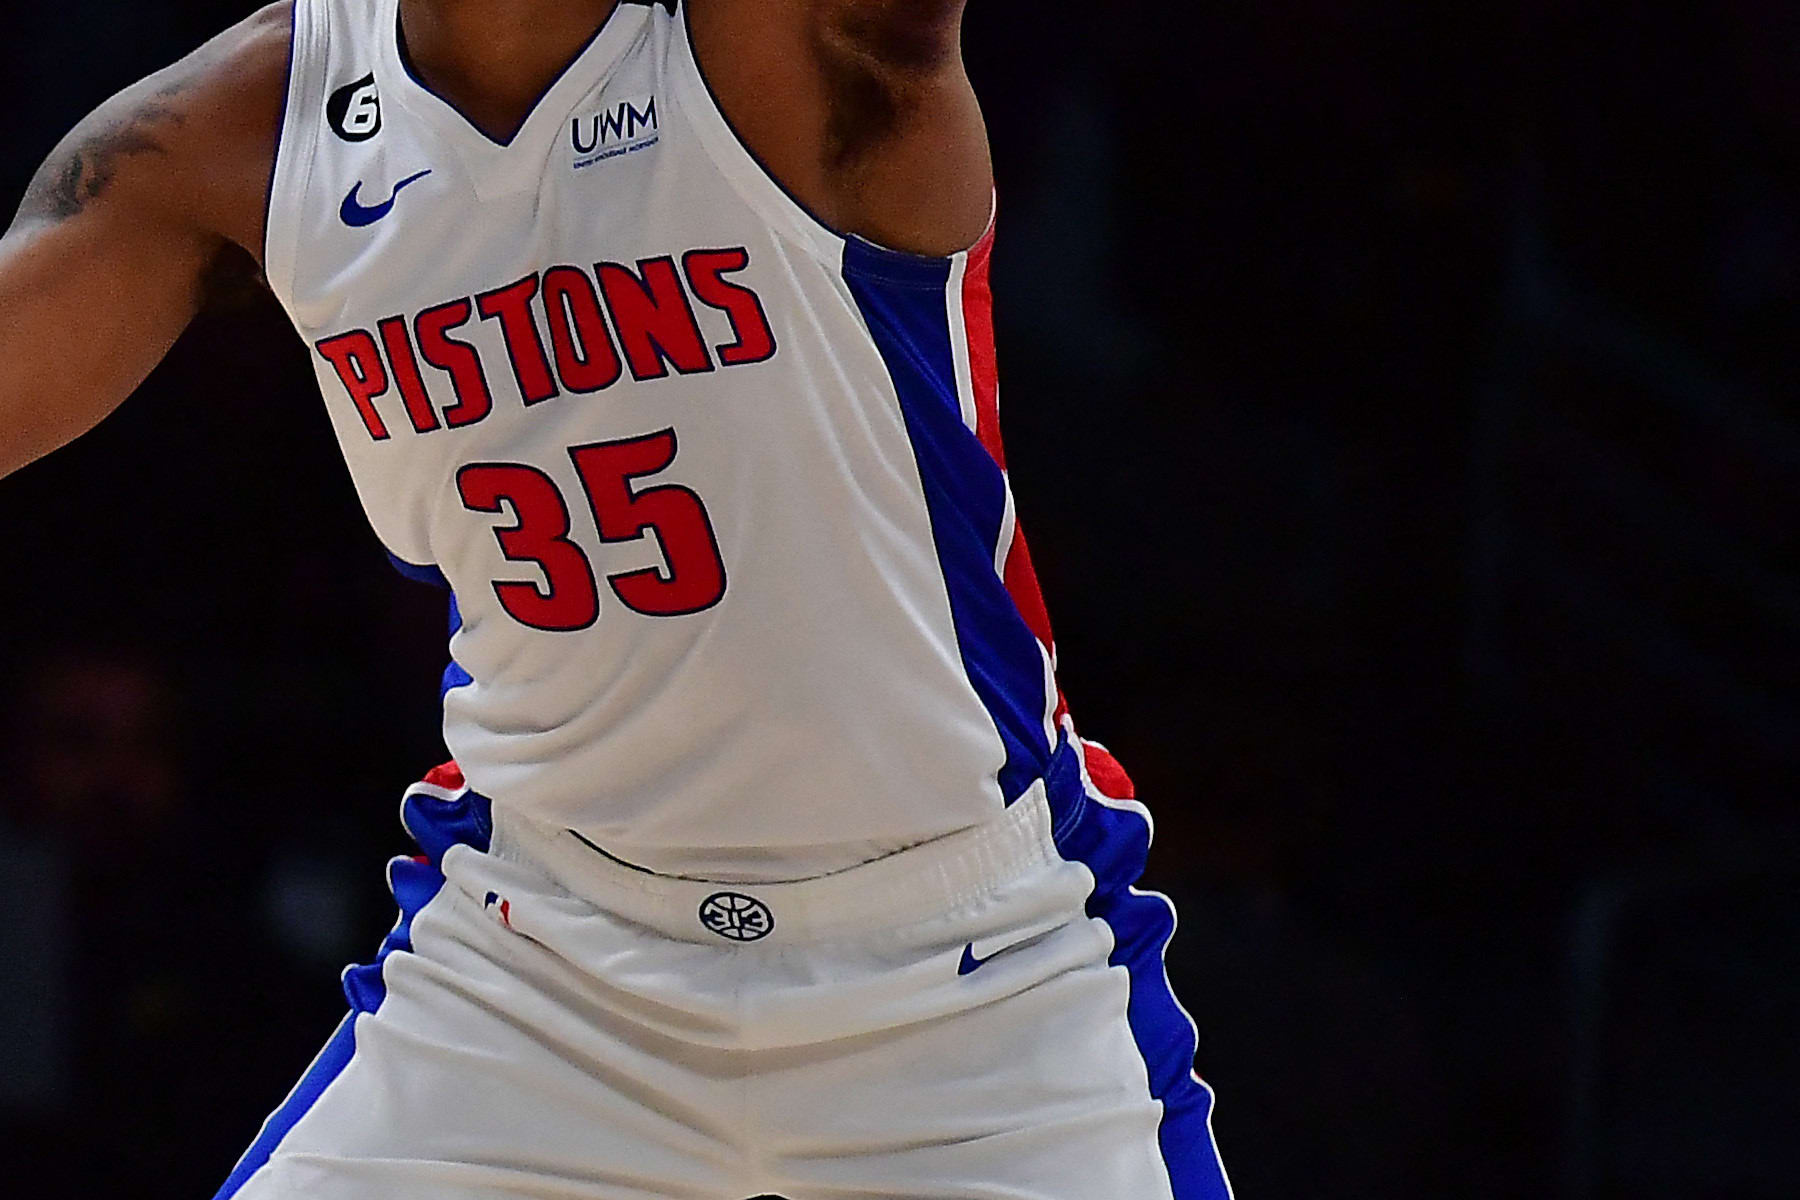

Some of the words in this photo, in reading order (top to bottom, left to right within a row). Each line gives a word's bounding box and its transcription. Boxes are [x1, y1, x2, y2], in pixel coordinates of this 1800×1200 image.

[341, 83, 378, 134] 6
[571, 95, 658, 154] UWM
[314, 246, 778, 441] PISTONS
[455, 426, 728, 632] 35
